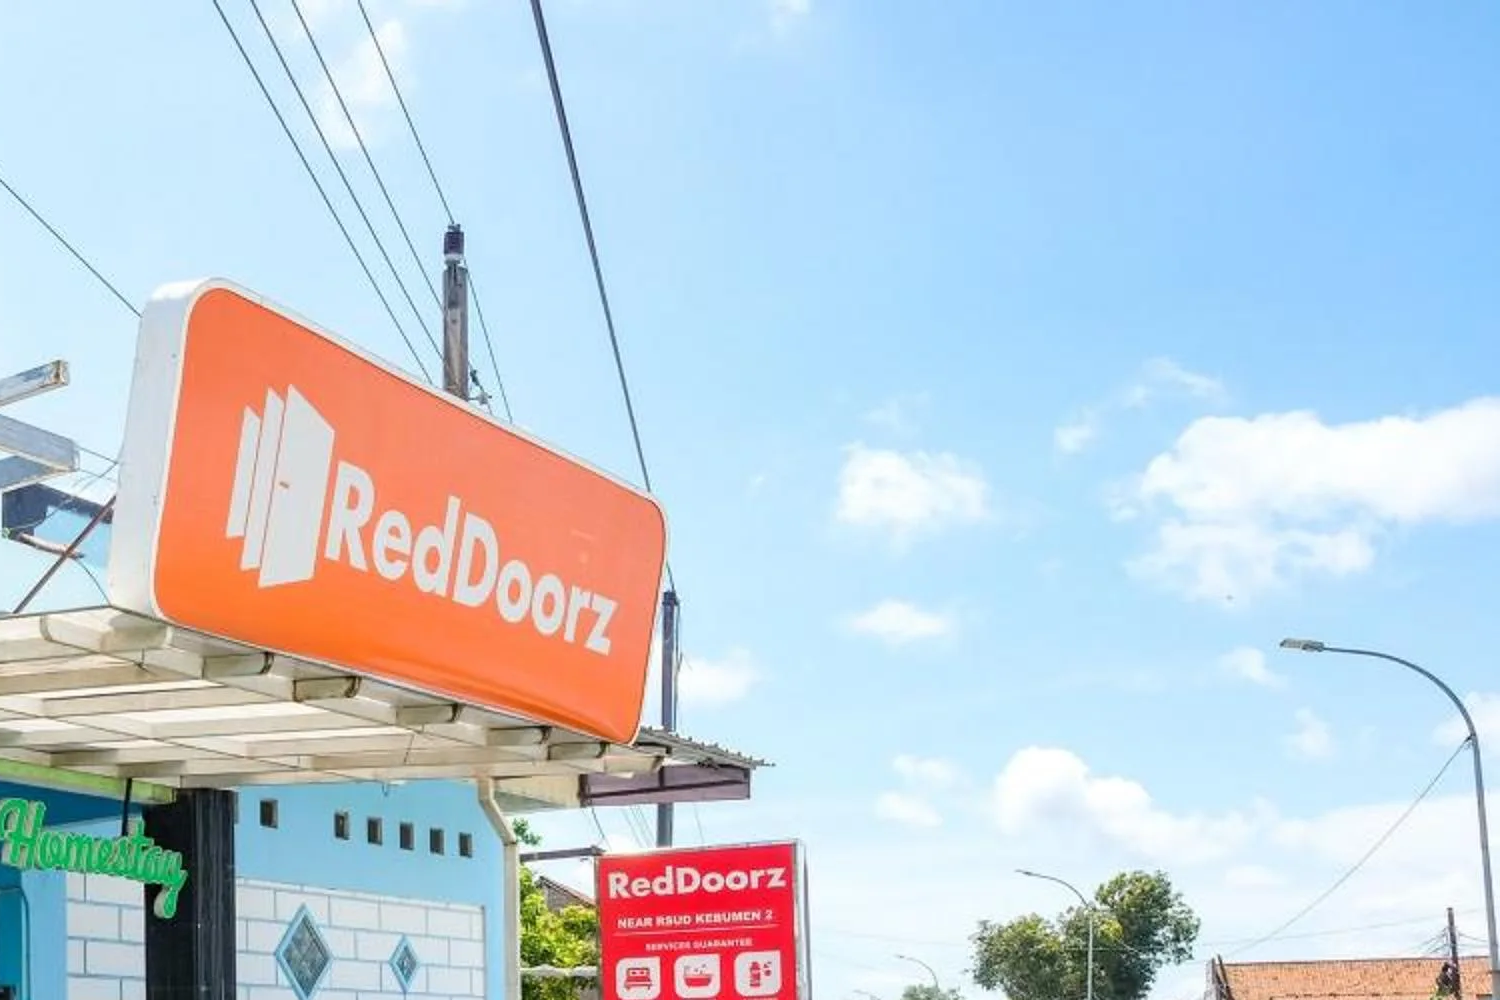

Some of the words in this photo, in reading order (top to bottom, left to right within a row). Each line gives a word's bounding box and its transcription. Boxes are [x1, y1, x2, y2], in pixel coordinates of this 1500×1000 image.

[325, 460, 619, 657] RedDoorz
[607, 865, 787, 899] RedDoorz
[617, 917, 653, 929] NEAR
[655, 915, 691, 926] RSUD
[695, 910, 761, 924] KEBUMEN
[765, 909, 773, 920] 2
